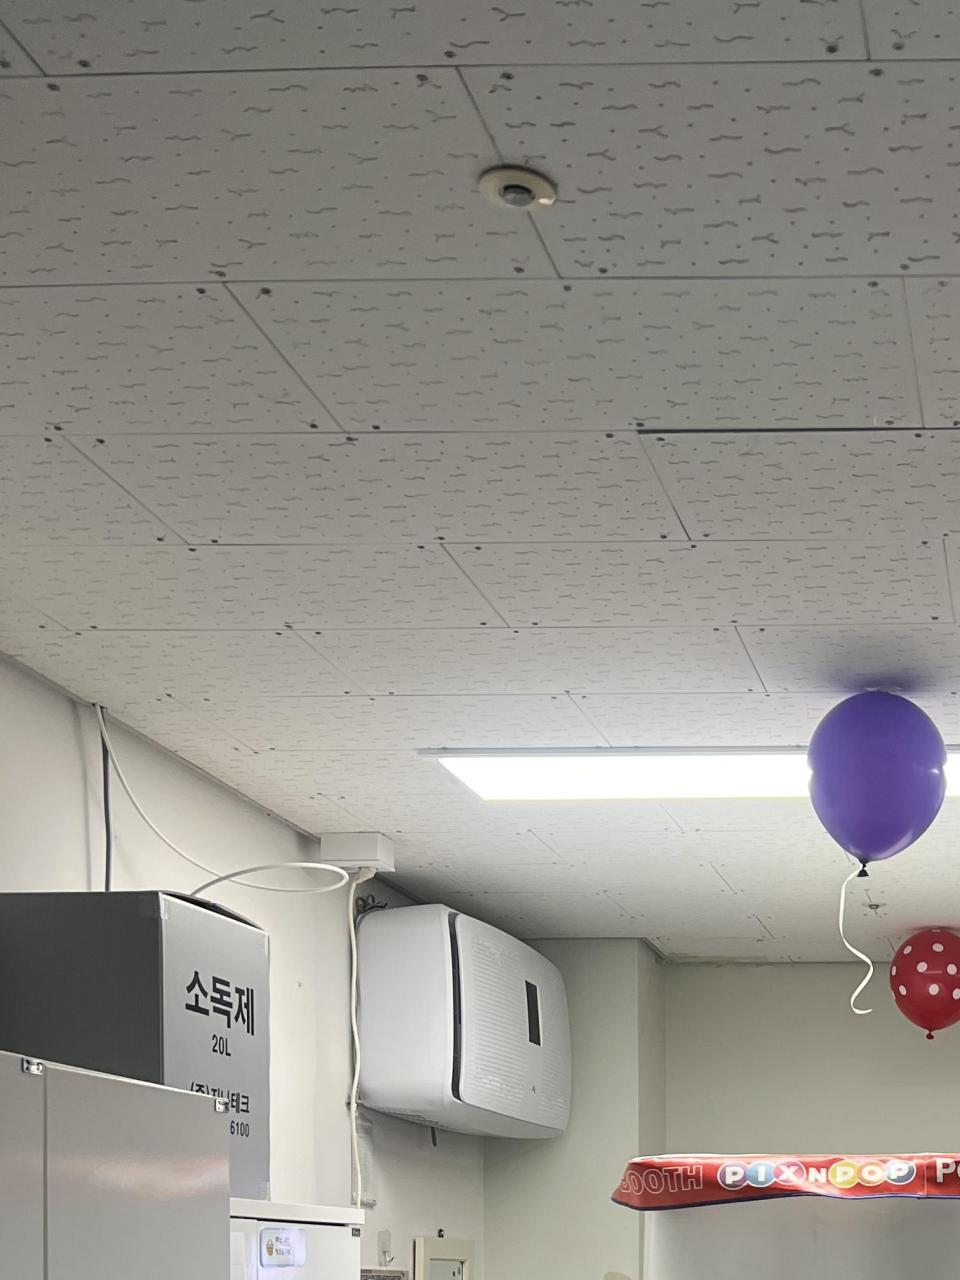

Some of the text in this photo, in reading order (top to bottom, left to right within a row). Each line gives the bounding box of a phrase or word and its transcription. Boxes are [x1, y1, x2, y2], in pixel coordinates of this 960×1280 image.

[185, 970, 255, 1036] 소독제
[212, 1034, 231, 1057] 20L
[717, 1159, 916, 1191] PIXNPOP
